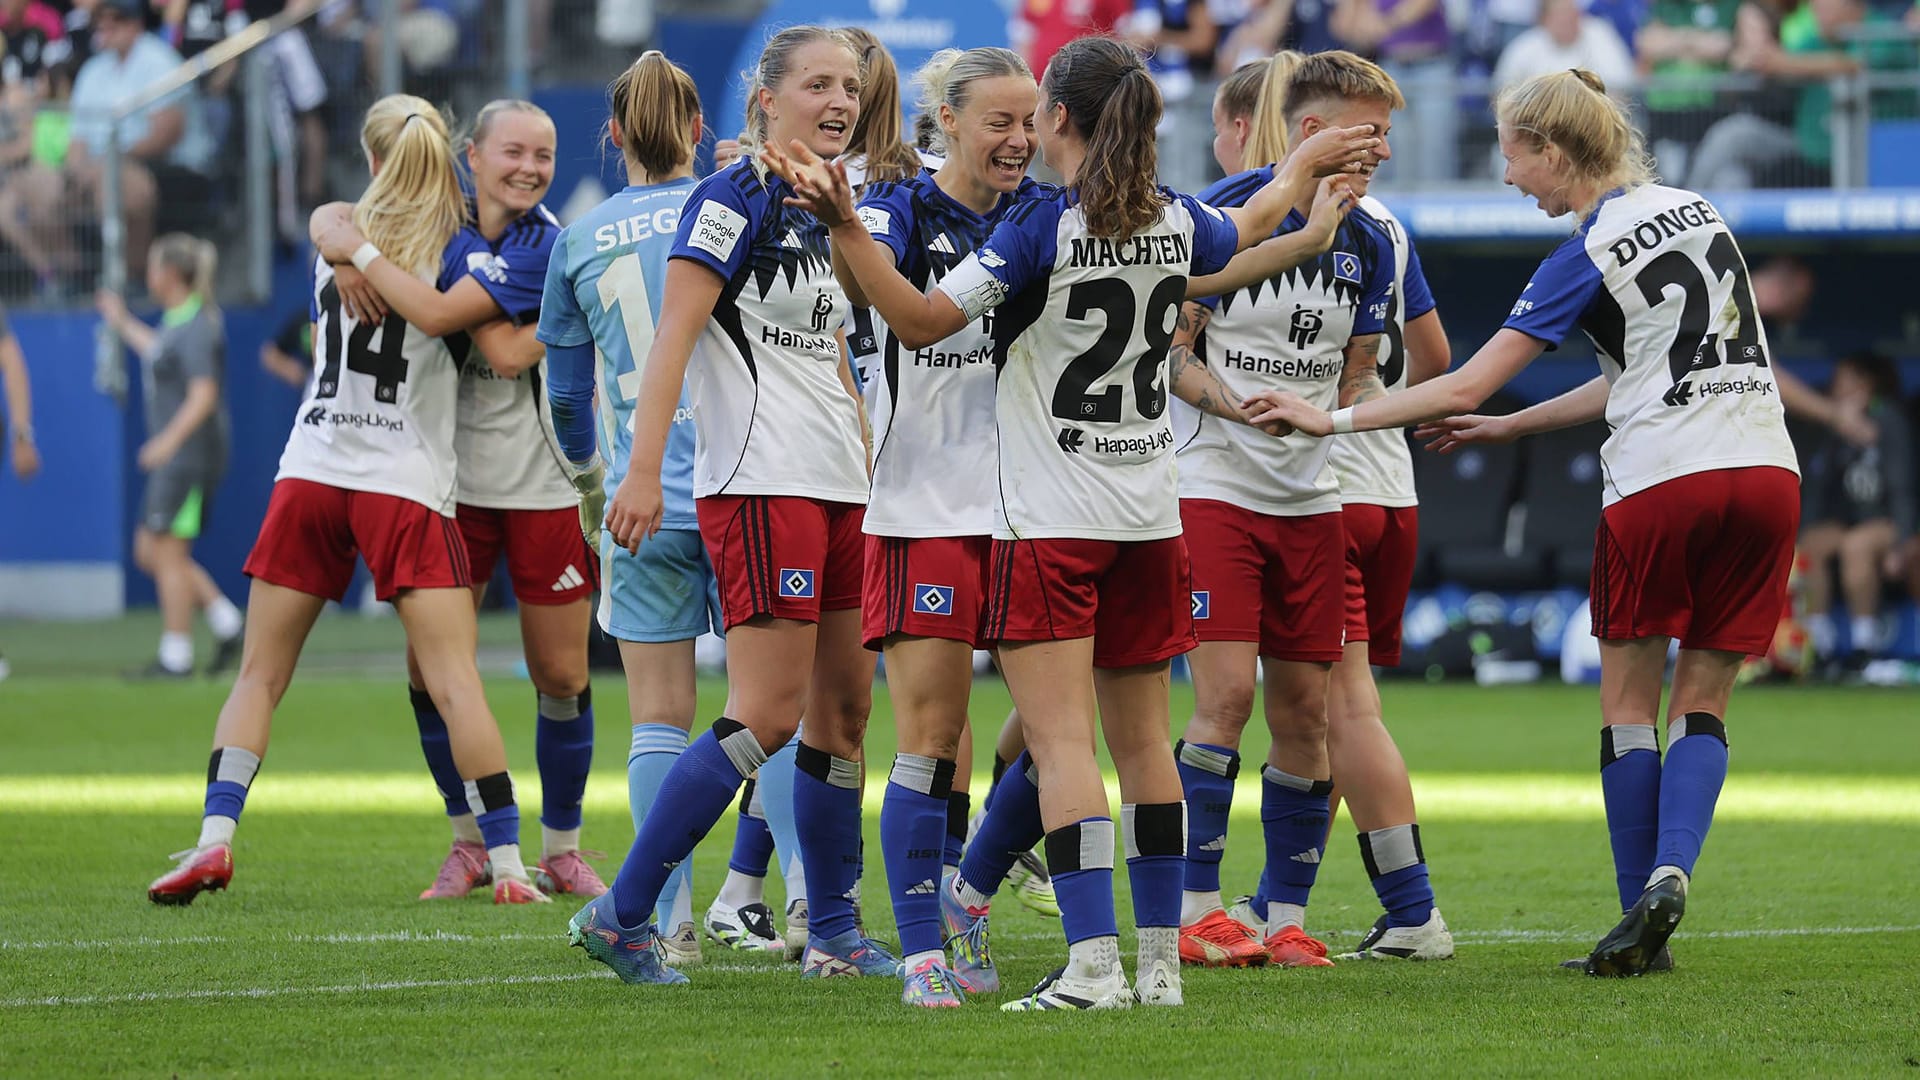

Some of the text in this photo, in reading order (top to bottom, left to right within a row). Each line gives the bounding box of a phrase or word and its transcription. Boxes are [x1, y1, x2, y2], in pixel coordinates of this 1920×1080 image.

[595, 208, 681, 252] SIEG
[699, 228, 725, 247] Pixel
[700, 214, 735, 239] Google
[1070, 232, 1188, 267] MACHTEN
[1634, 231, 1768, 386] 21
[315, 275, 409, 404] 14
[1052, 275, 1187, 423] 28
